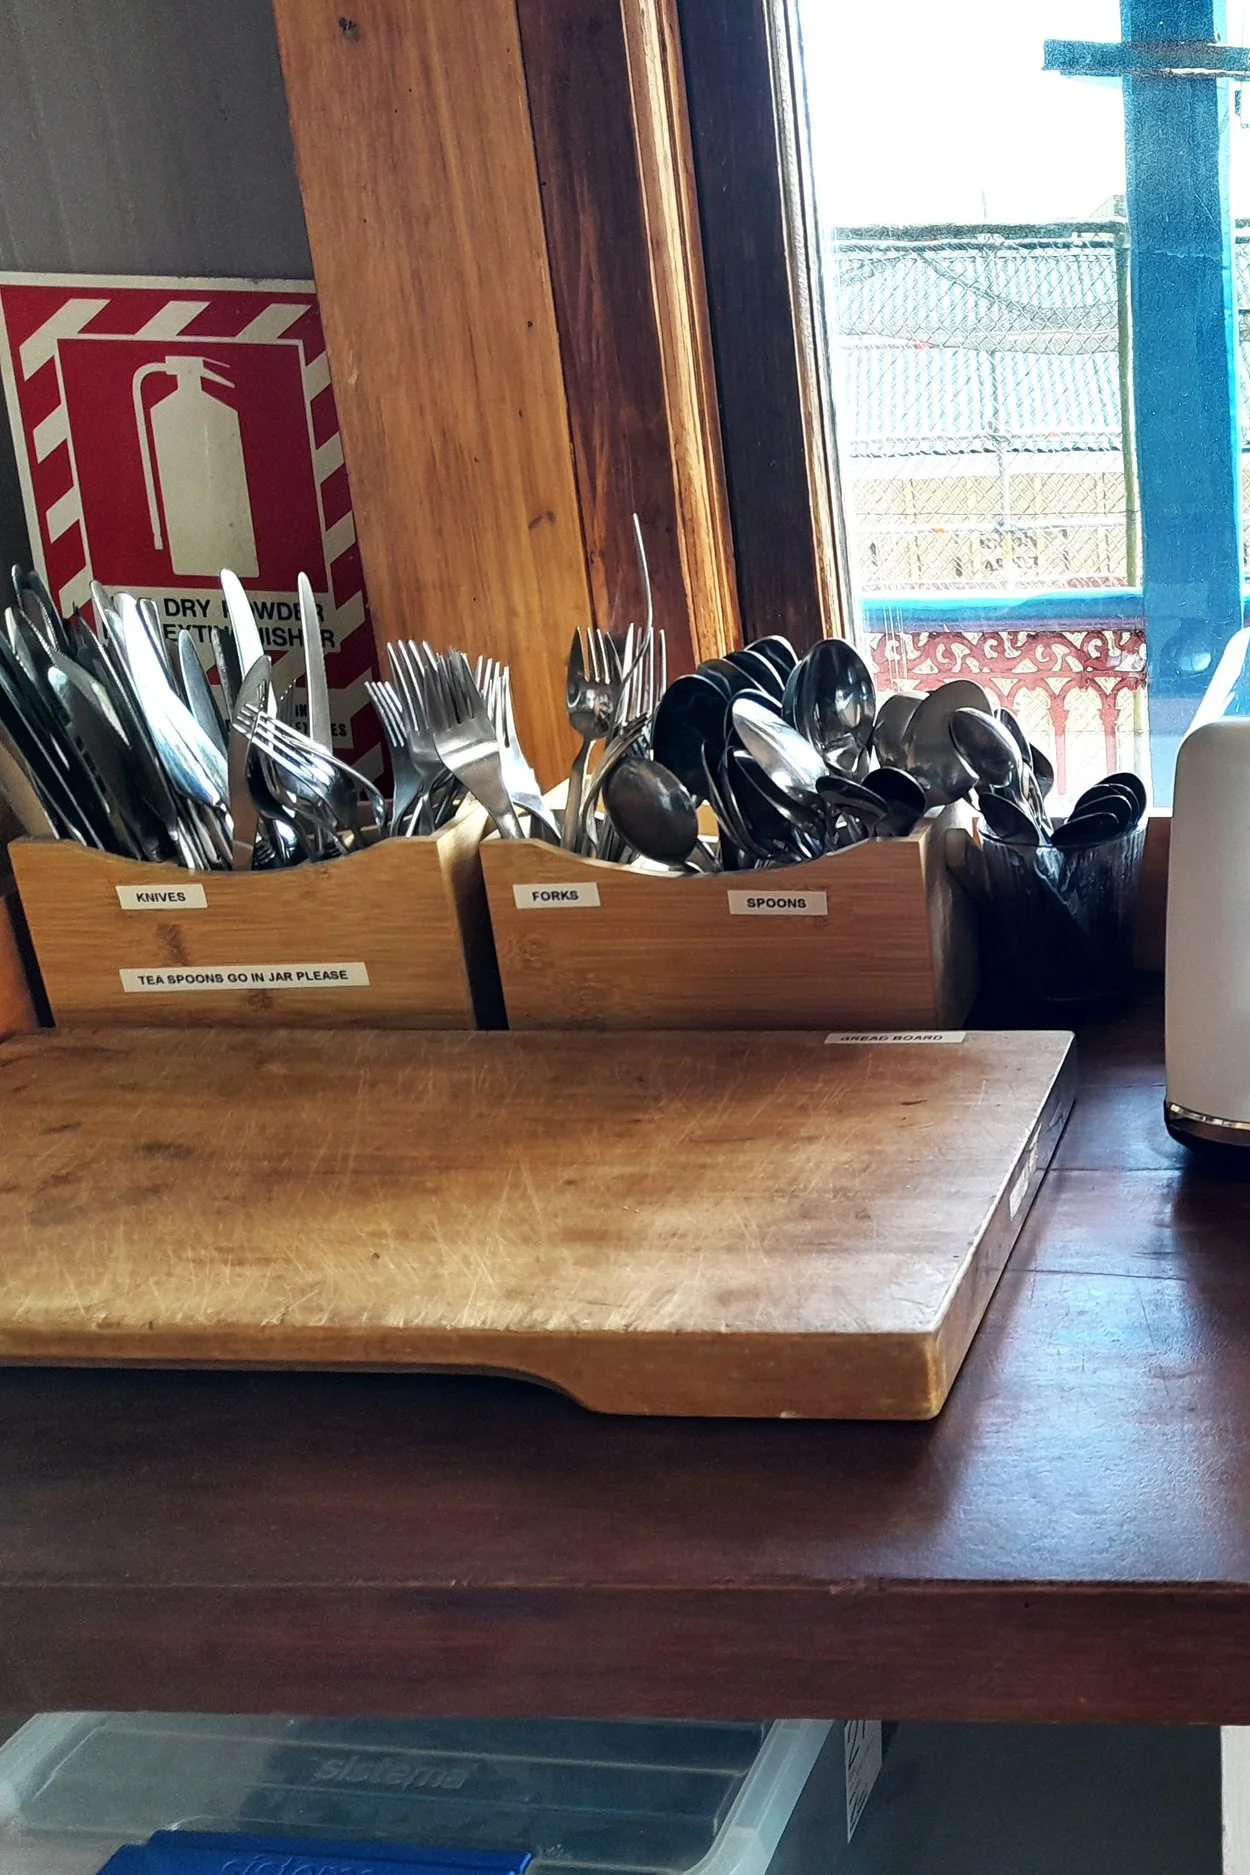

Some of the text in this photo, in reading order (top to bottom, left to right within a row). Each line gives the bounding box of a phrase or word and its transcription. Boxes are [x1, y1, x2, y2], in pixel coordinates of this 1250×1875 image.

[164, 598, 210, 618] DRY
[222, 600, 326, 623] WDR
[136, 892, 186, 903] KNIVES
[532, 890, 579, 902] FORKS
[746, 897, 807, 909] SPOONS
[138, 970, 349, 986] TEA SPOONS GO IN JAR PLEASE
